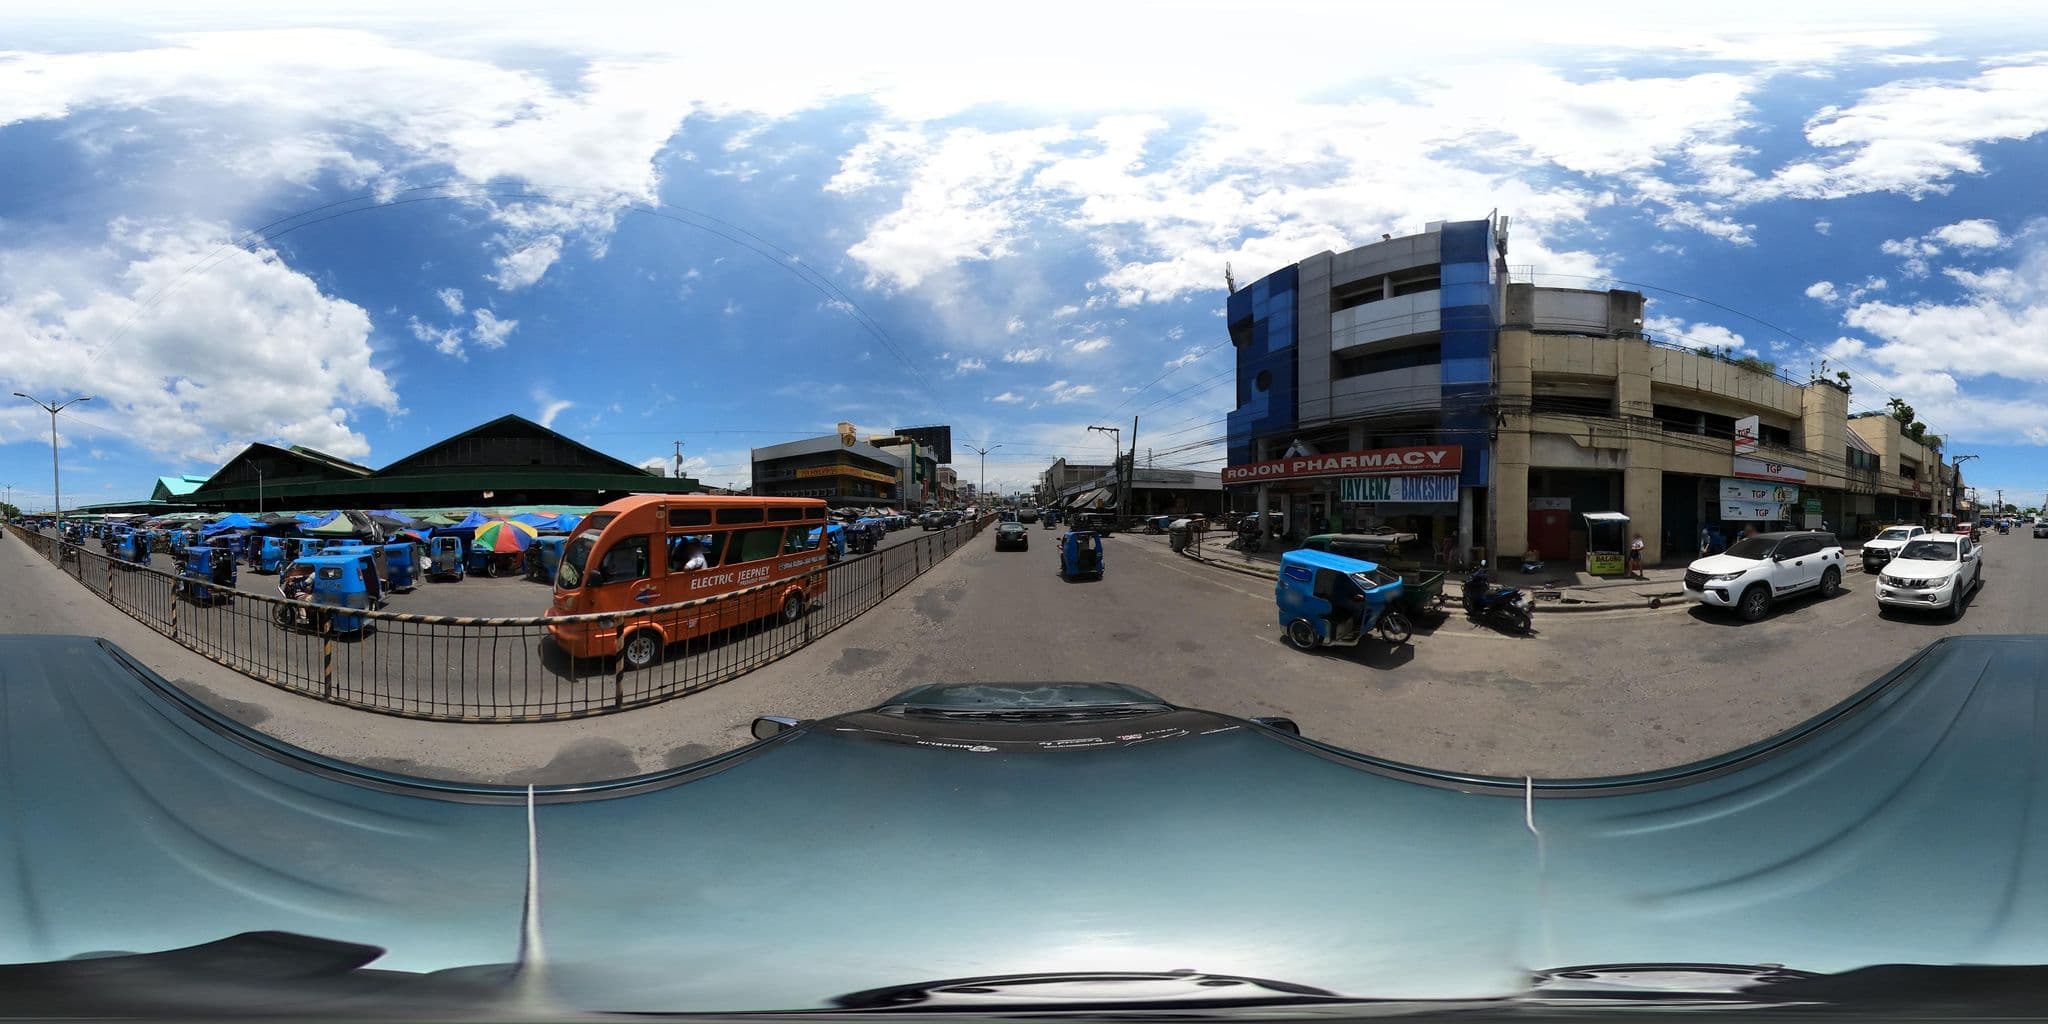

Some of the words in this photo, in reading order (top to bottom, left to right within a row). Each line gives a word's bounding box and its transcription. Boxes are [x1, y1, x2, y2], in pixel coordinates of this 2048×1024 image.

[1227, 464, 1285, 479] ROJON
[1293, 450, 1447, 472] PHARMACY
[1765, 463, 1782, 474] TGP
[1341, 478, 1391, 500] JAYLENZ
[1401, 476, 1457, 500] BAKESHOP
[1751, 490, 1766, 499] TGP
[1754, 508, 1769, 517] TGP
[691, 573, 734, 590] ELECTRIC
[736, 566, 770, 584] JEEPNEY
